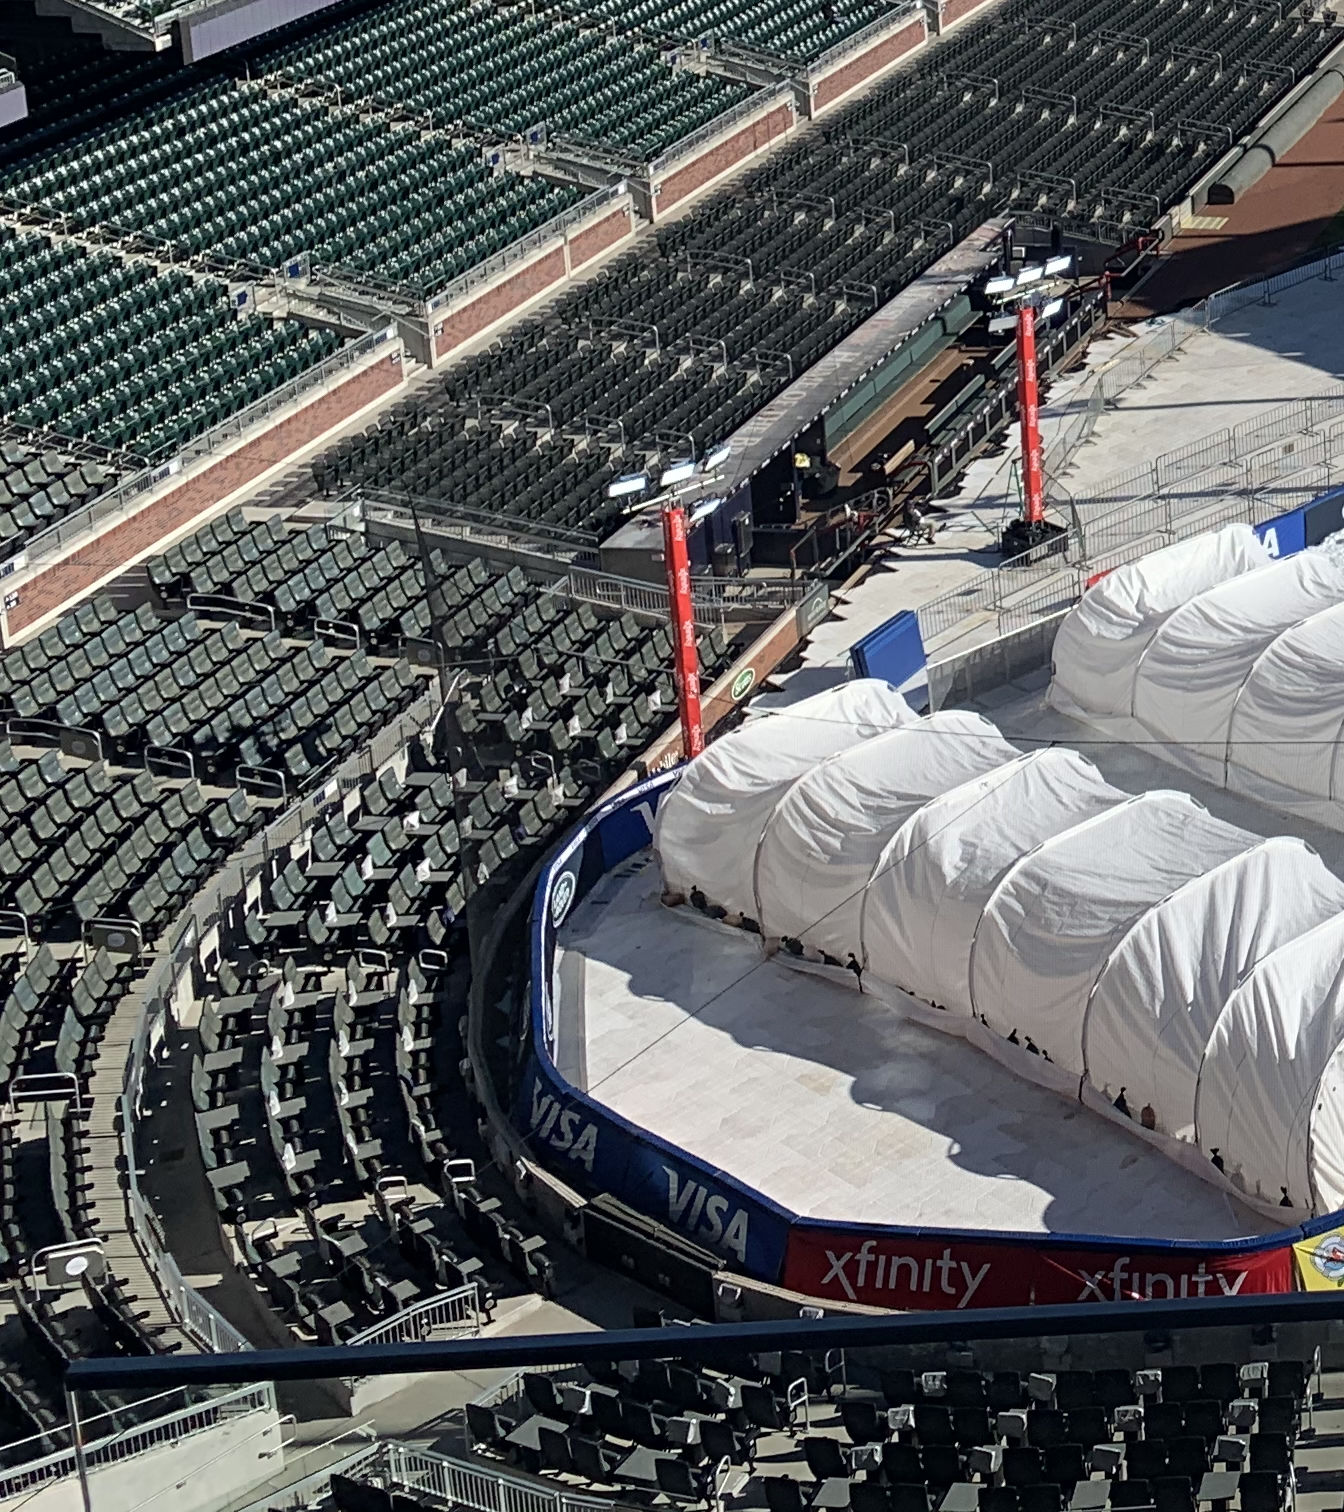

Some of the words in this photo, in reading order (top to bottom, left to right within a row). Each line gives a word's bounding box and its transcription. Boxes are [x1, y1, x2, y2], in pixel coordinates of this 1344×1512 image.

[530, 1080, 599, 1174] VISA
[662, 1166, 749, 1263] VISA
[820, 1240, 992, 1309] xfinity
[1078, 1257, 1248, 1301] xfinity
